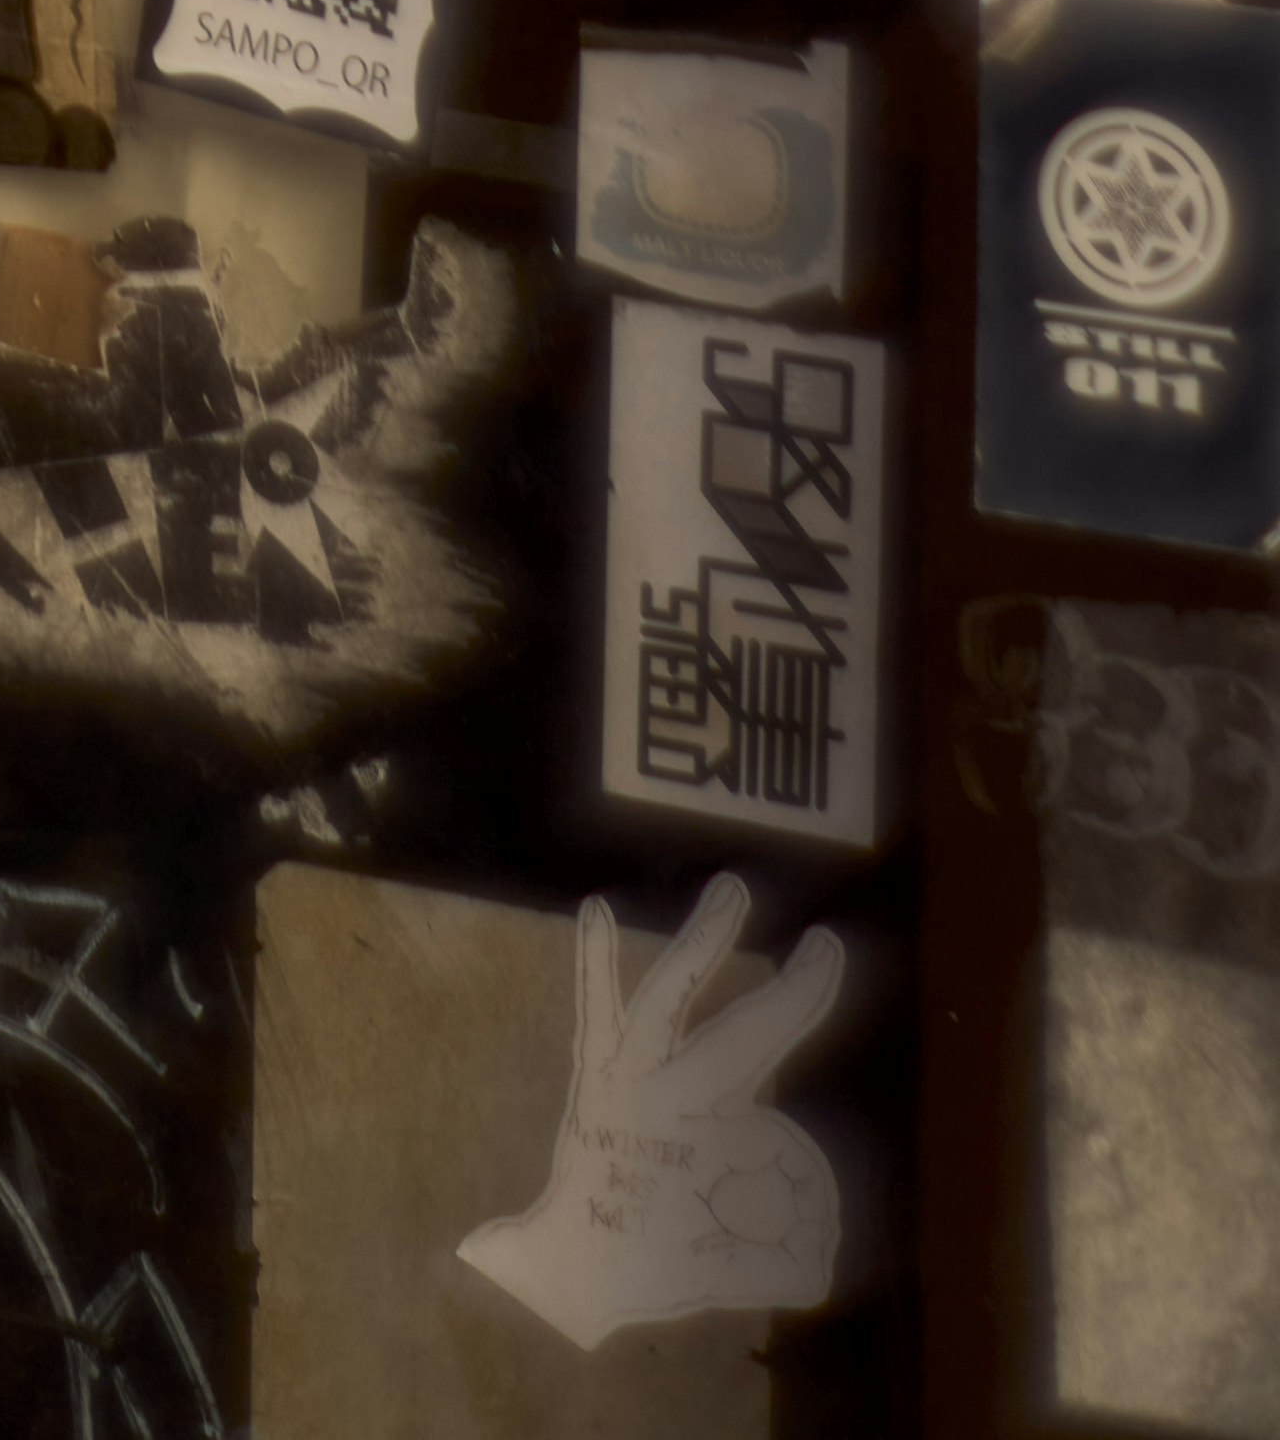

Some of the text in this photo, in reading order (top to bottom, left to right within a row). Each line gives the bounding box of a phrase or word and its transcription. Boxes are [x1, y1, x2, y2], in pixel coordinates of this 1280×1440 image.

[193, 9, 391, 100] SAMPO_QR
[632, 231, 695, 264] MALT
[1043, 319, 1228, 375] STILL
[1063, 355, 1205, 417] 011
